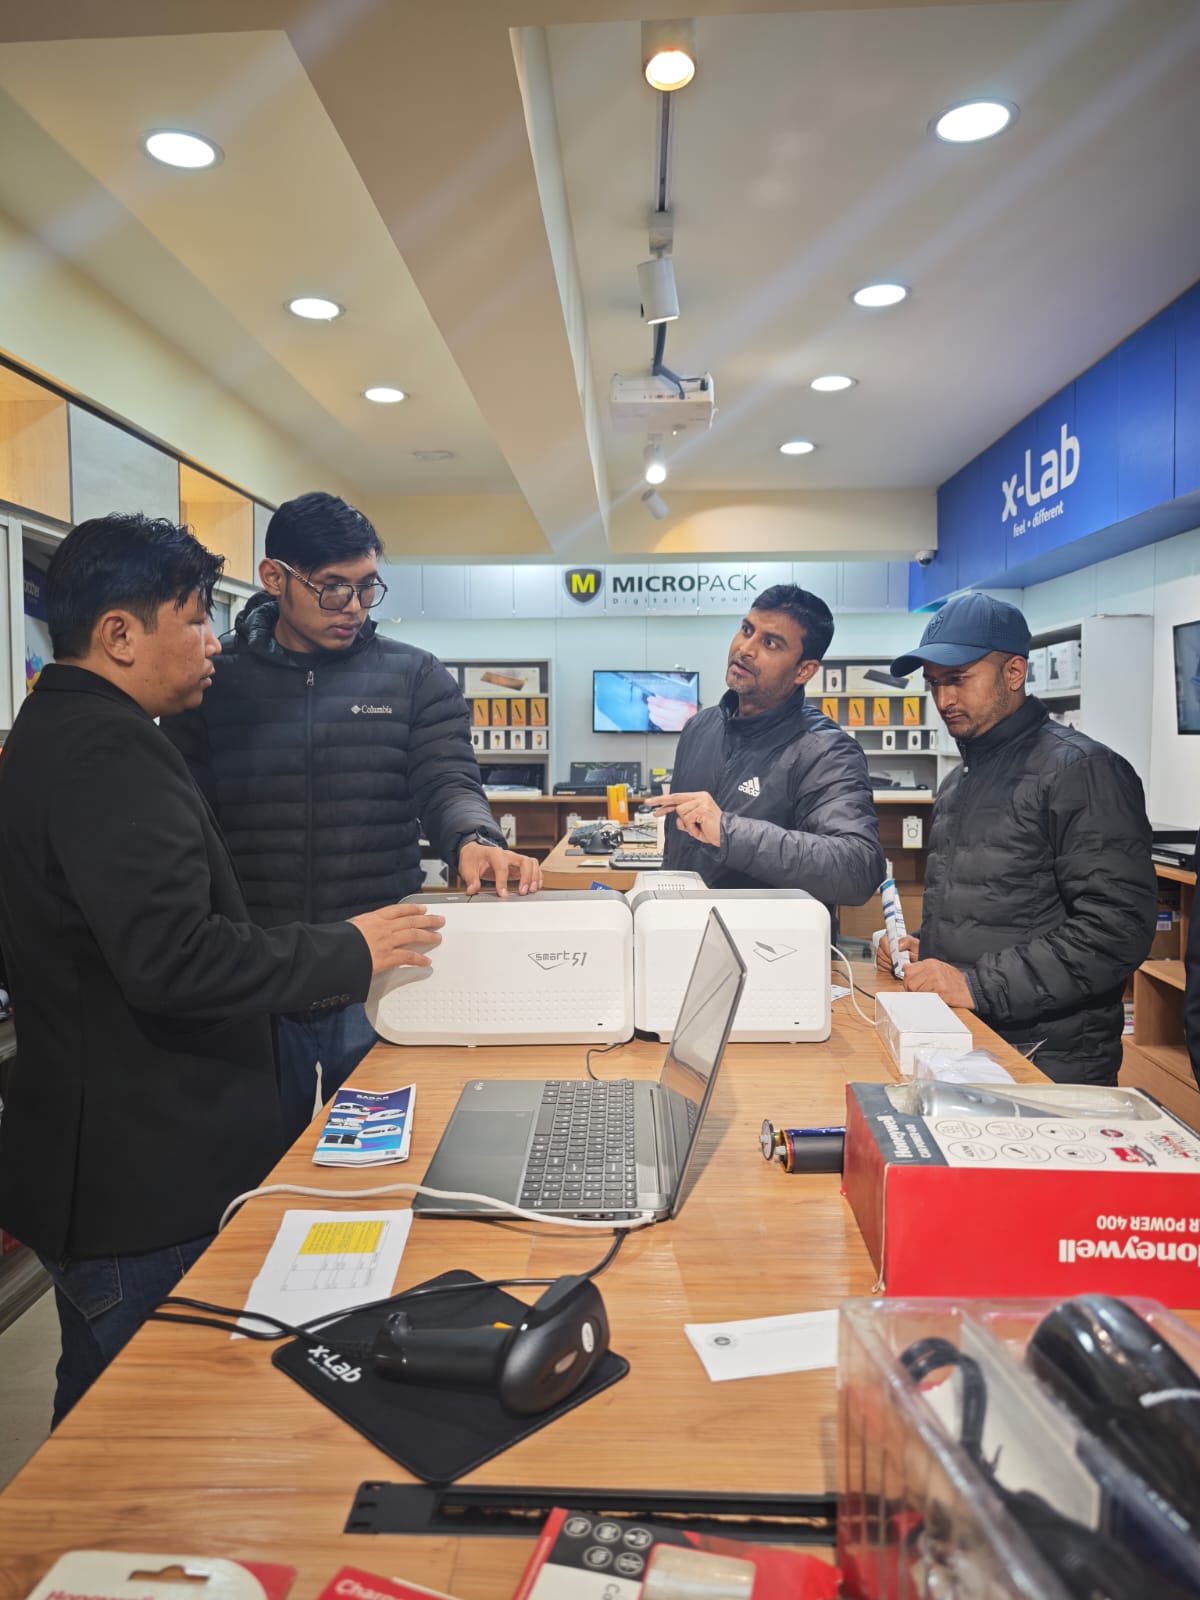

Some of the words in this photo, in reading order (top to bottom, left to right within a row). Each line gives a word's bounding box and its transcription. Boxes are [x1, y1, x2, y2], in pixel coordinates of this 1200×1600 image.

[1002, 423, 1080, 523] x-Lab
[1013, 519, 1026, 537] feel
[1032, 500, 1064, 528] different
[571, 574, 595, 593] M
[612, 574, 757, 592] MICROPACK
[361, 704, 393, 714] Columbia
[535, 950, 570, 961] smart
[572, 952, 587, 966] 51
[876, 1115, 914, 1158] Honeywell
[1096, 1215, 1128, 1230] 400
[1130, 1216, 1186, 1232] POWER
[1058, 1236, 1200, 1268] oneywell
[307, 1345, 362, 1383] x-Lab
